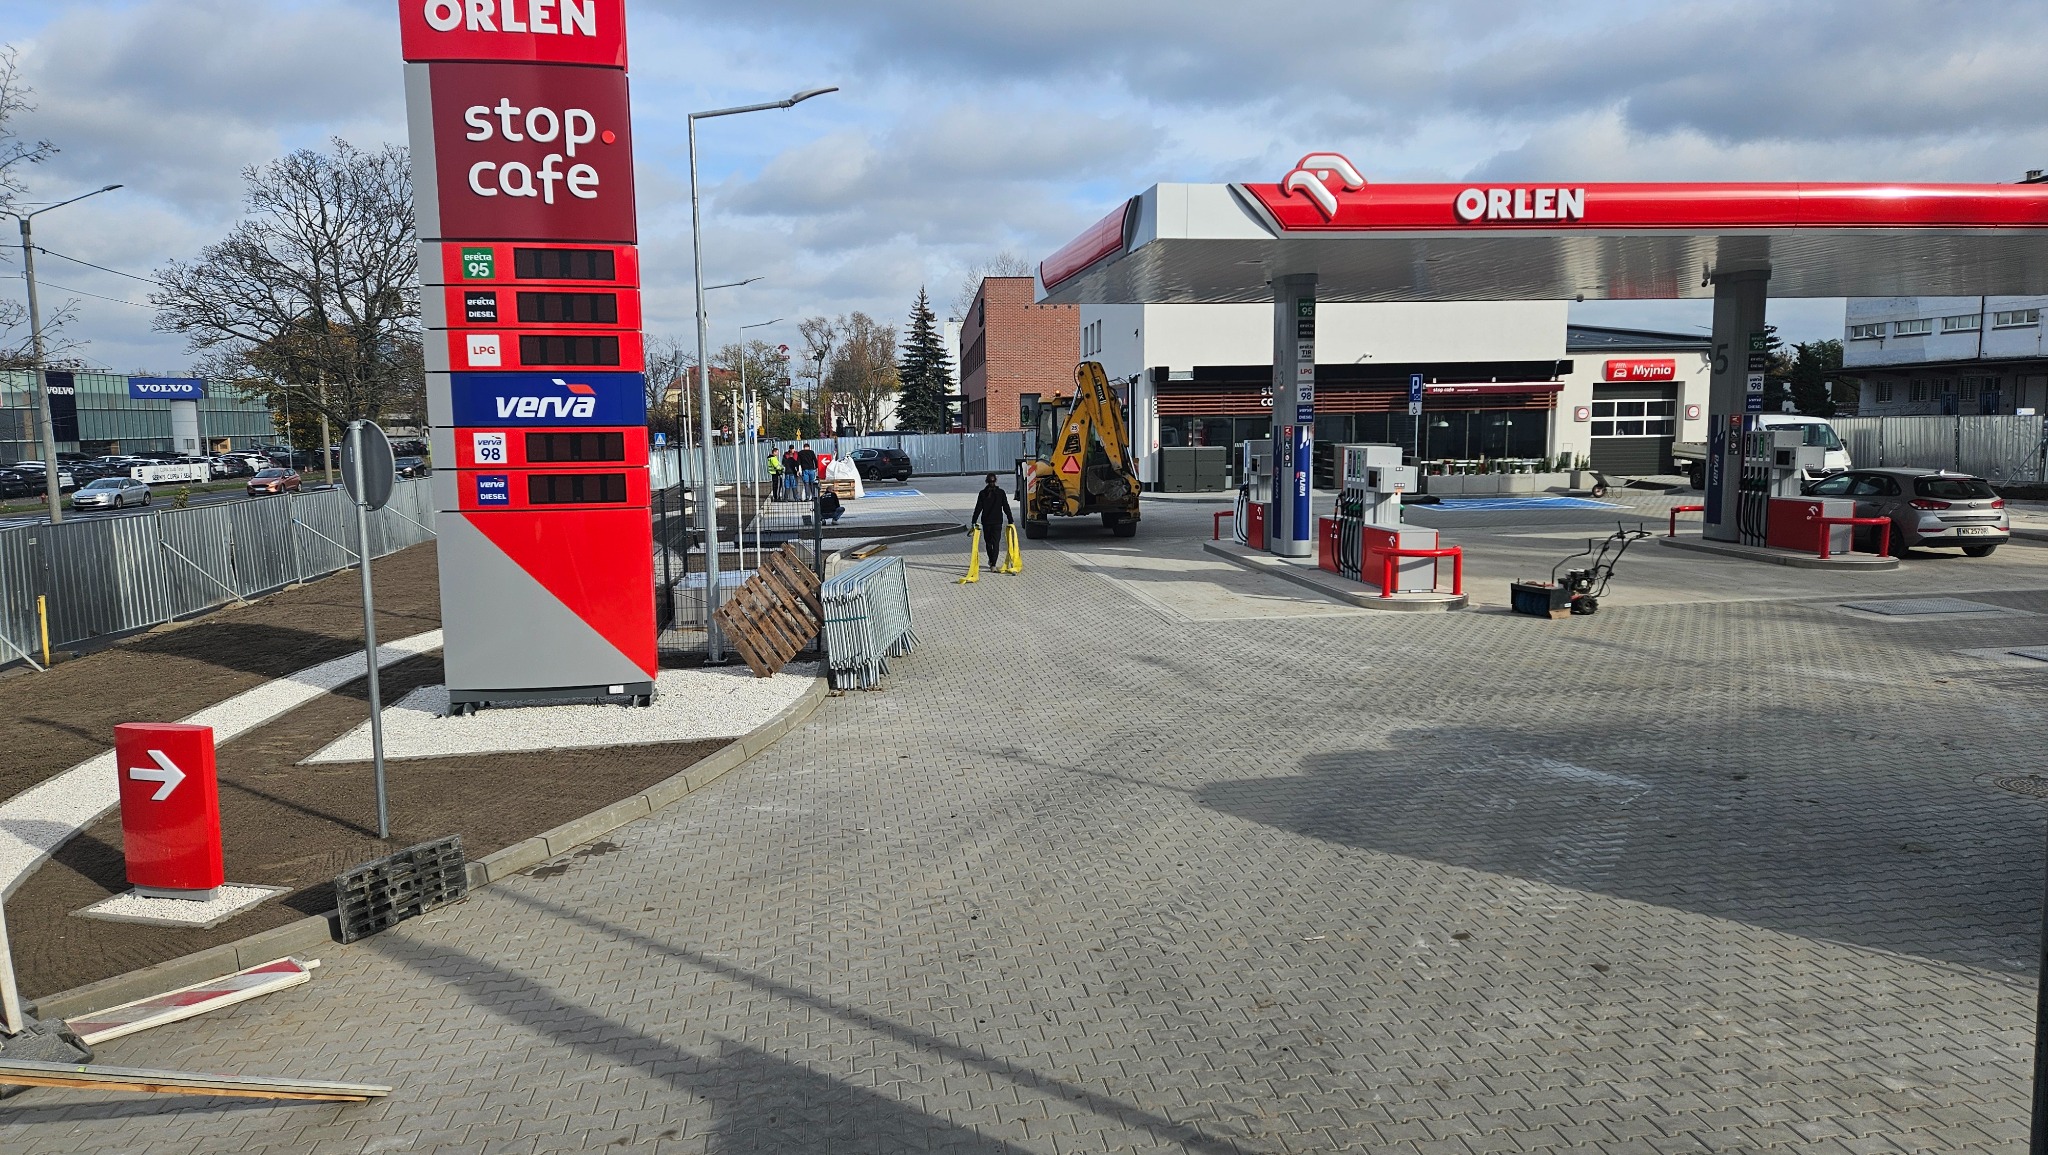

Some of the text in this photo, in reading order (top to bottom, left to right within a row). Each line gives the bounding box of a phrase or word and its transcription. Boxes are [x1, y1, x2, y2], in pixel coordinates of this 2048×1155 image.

[424, 0, 597, 37] ORLEN
[468, 154, 600, 205] cafe
[1456, 187, 1585, 221] ORLEN
[468, 262, 490, 277] 95
[468, 310, 496, 318] DIESEL
[1301, 306, 1313, 316] 95
[473, 345, 496, 356] LPG
[1753, 341, 1764, 350] 95
[1714, 343, 1729, 375] 5
[1632, 364, 1672, 378] Myjnia
[46, 386, 75, 395] VOLVO
[136, 384, 194, 393] VOLVO
[1412, 376, 1420, 394] P
[1751, 382, 1762, 391] 98
[1301, 391, 1312, 401] 98
[496, 396, 596, 418] verva
[481, 447, 501, 461] 98
